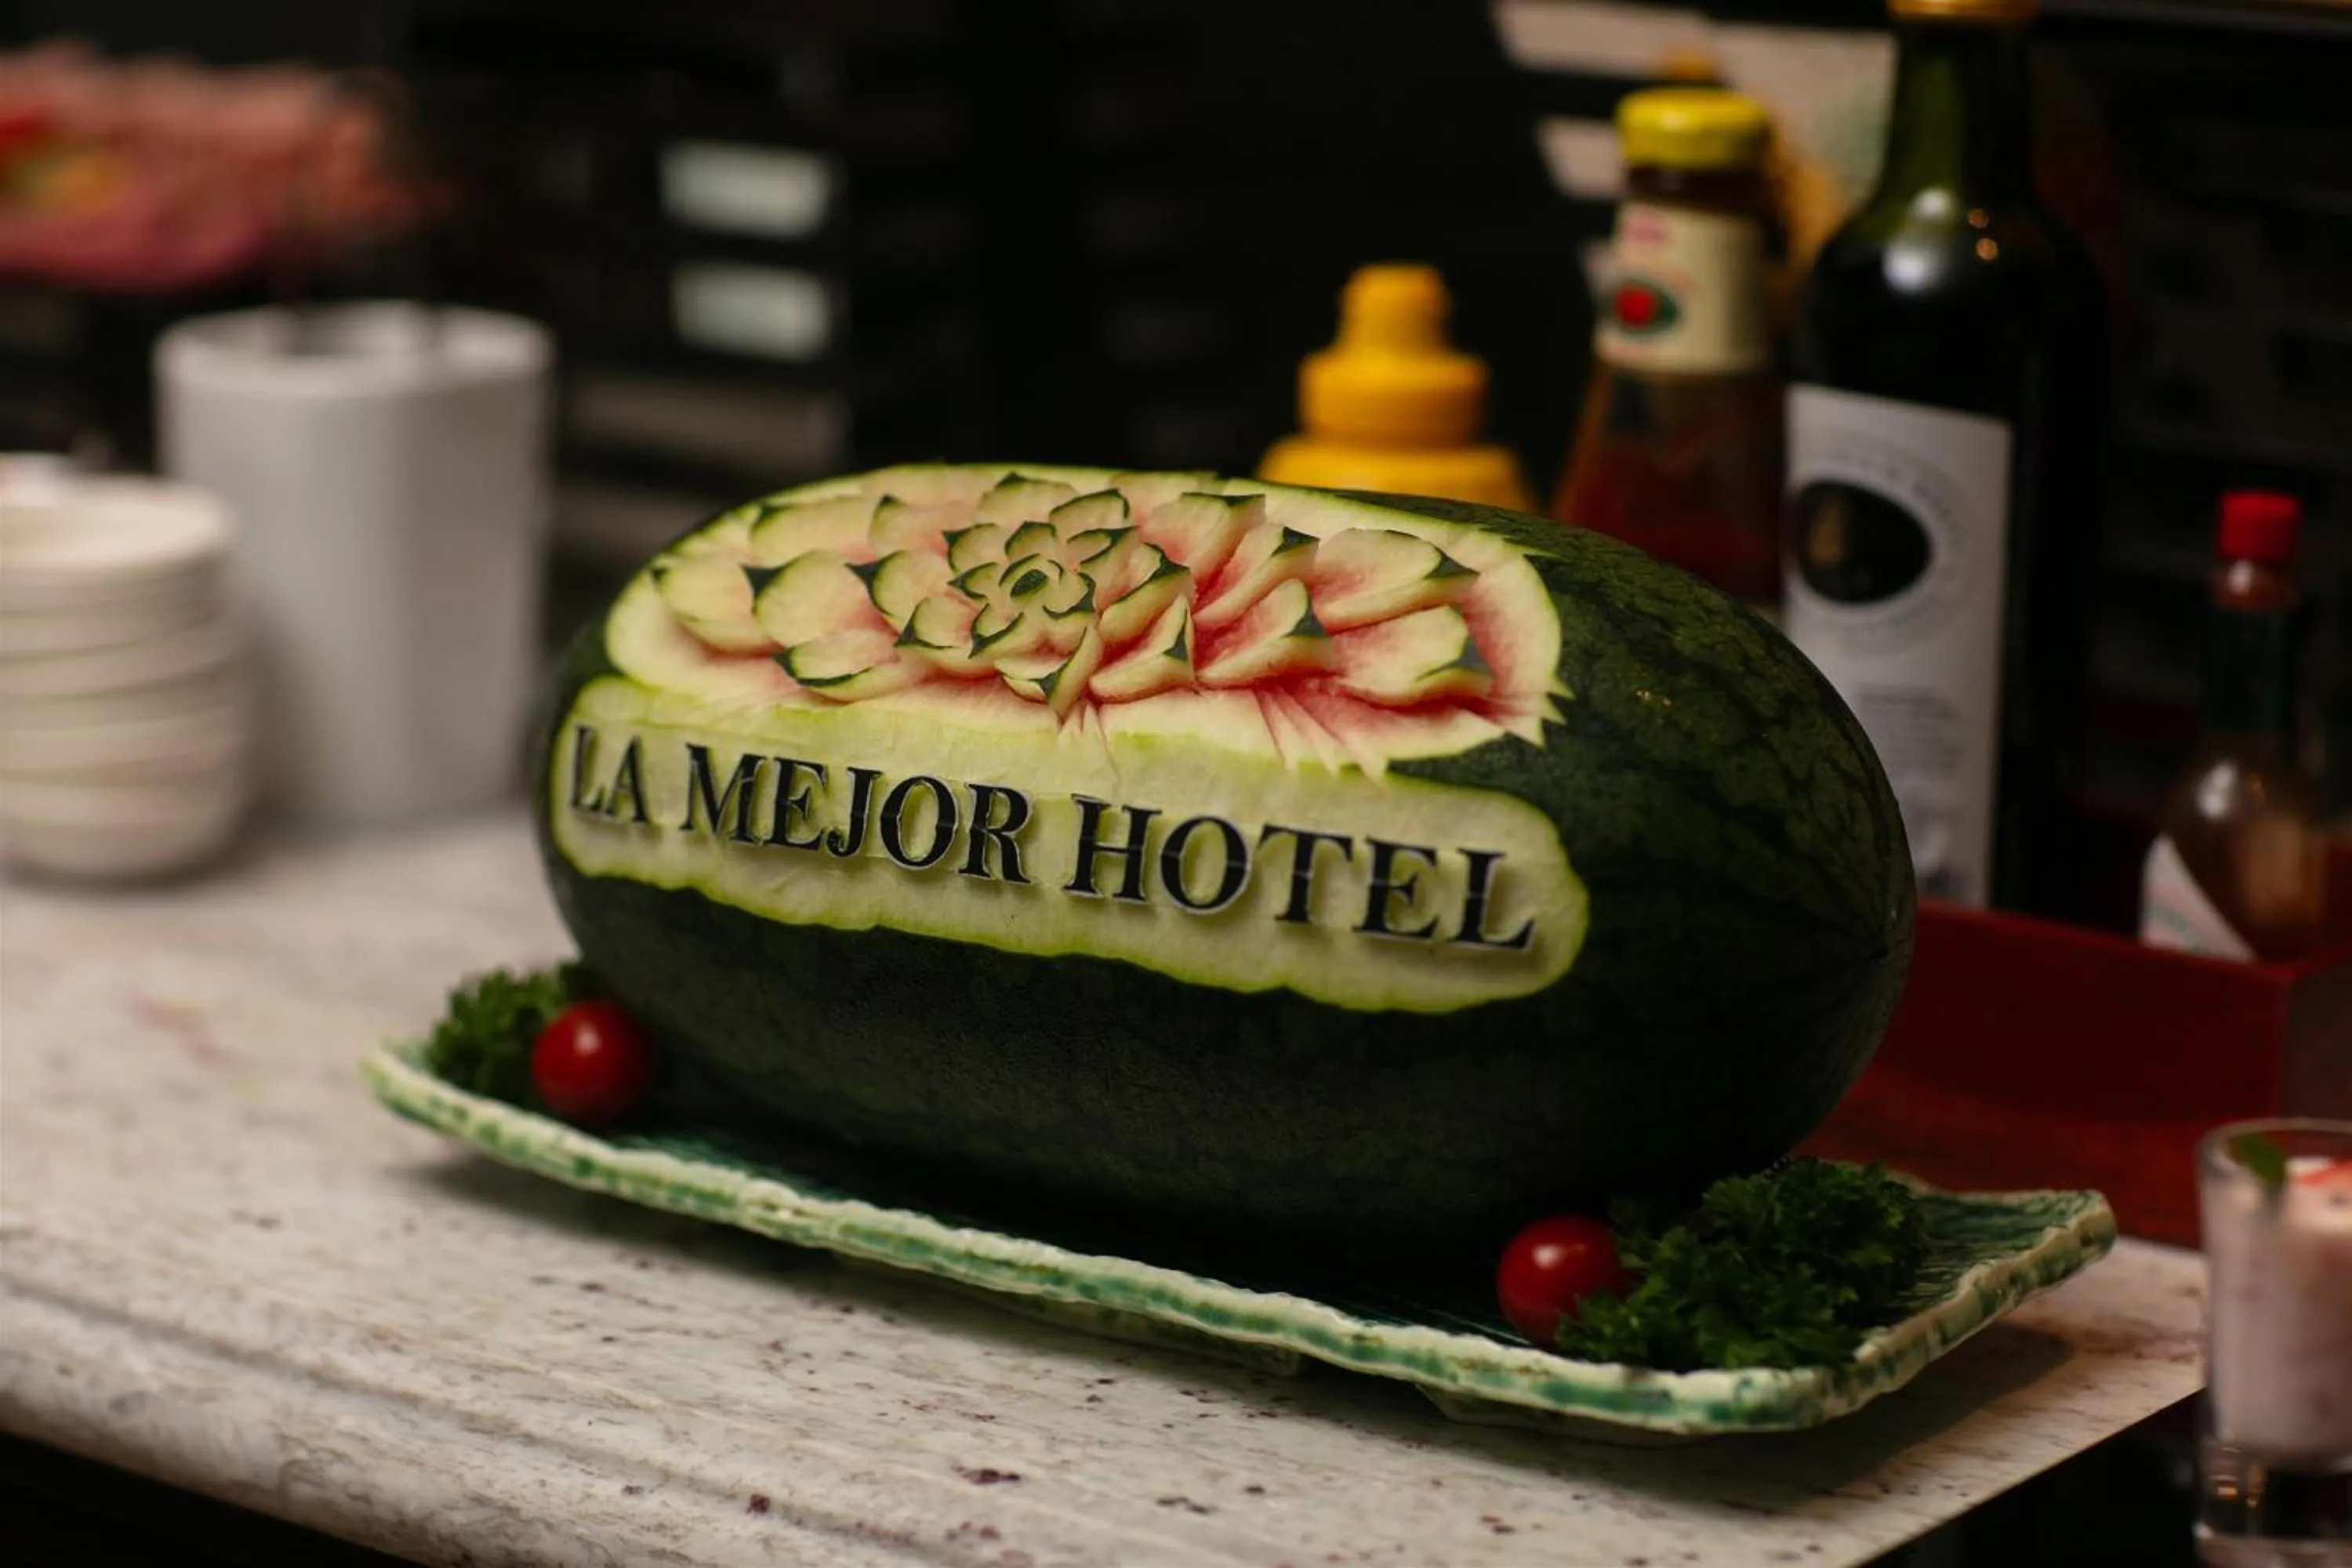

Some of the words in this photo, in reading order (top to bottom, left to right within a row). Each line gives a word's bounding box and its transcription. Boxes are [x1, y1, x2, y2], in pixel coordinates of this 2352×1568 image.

[570, 725, 650, 828] LA
[679, 742, 1033, 886] MEJOR
[1063, 793, 1536, 950] HOTEL
